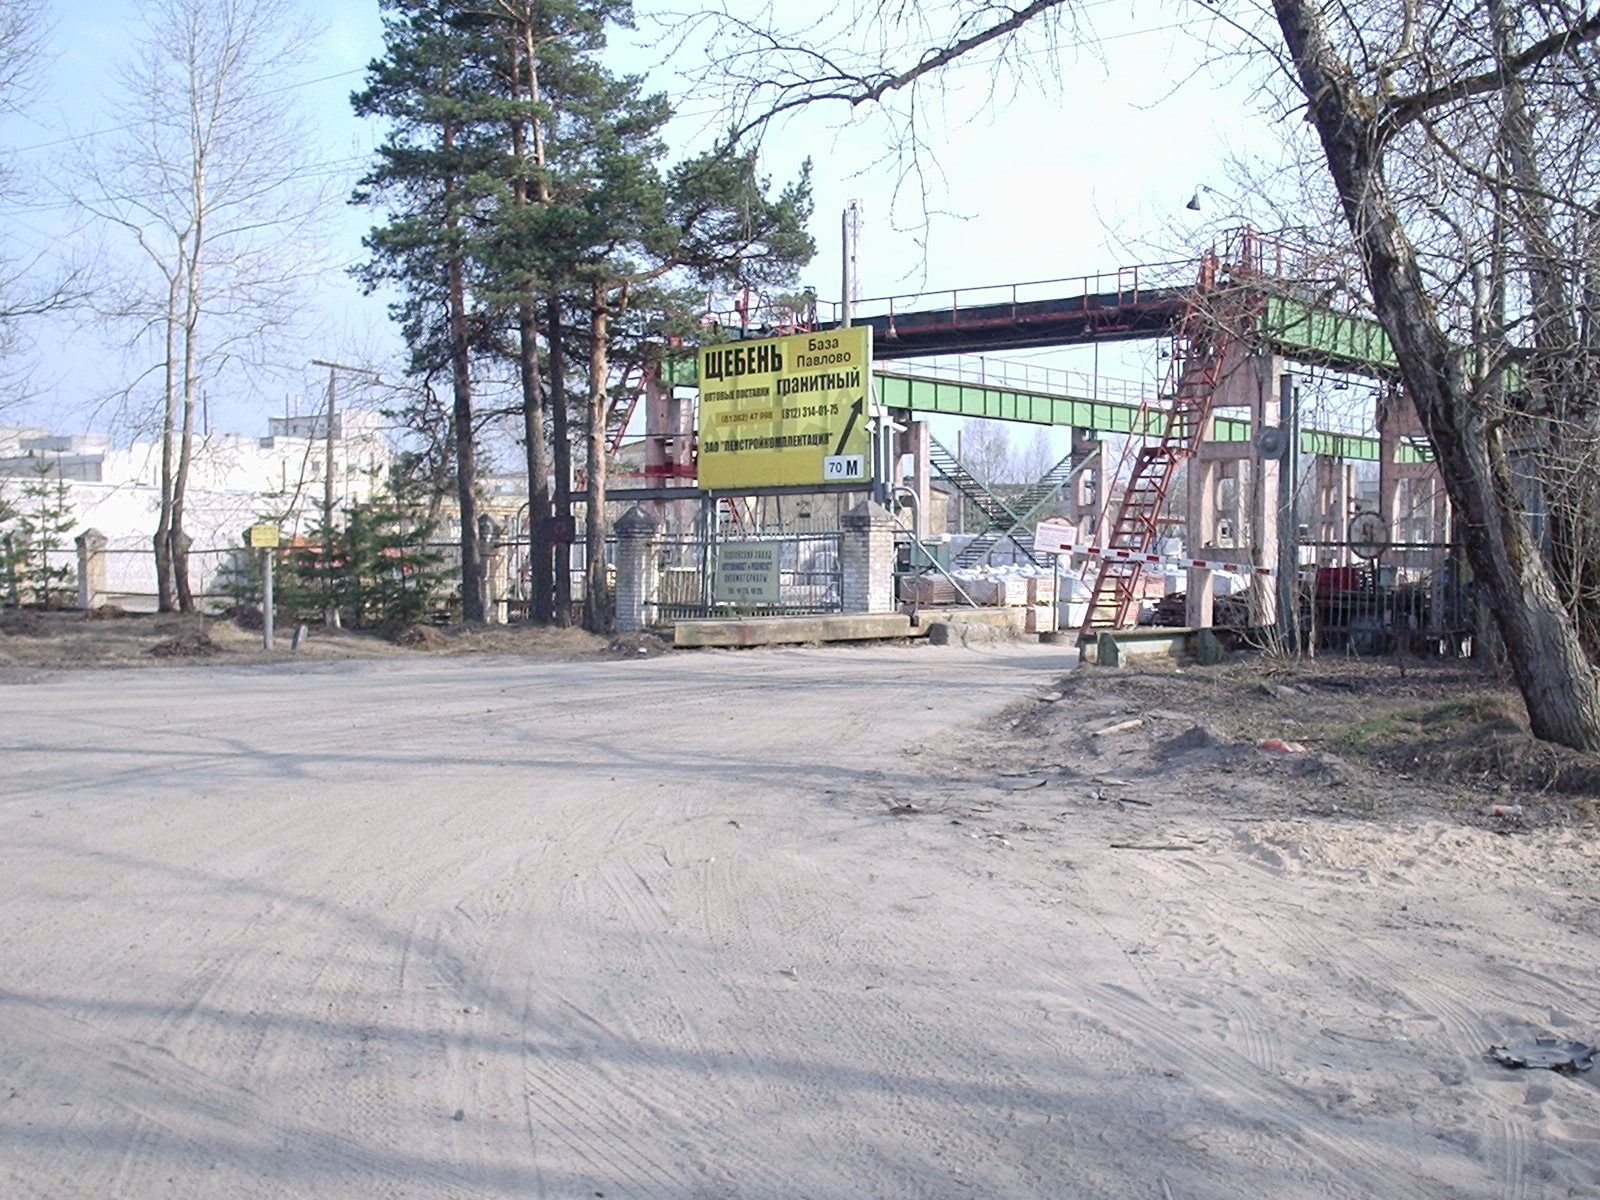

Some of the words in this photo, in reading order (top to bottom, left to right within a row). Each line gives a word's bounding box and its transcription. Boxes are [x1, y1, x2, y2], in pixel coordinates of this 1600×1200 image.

[808, 338, 839, 352] База
[705, 344, 783, 381] ЩЕБЕНЬ
[797, 352, 851, 368] Павлово
[777, 367, 860, 396] гранитный
[829, 462, 842, 473] 70
[846, 459, 858, 476] М
